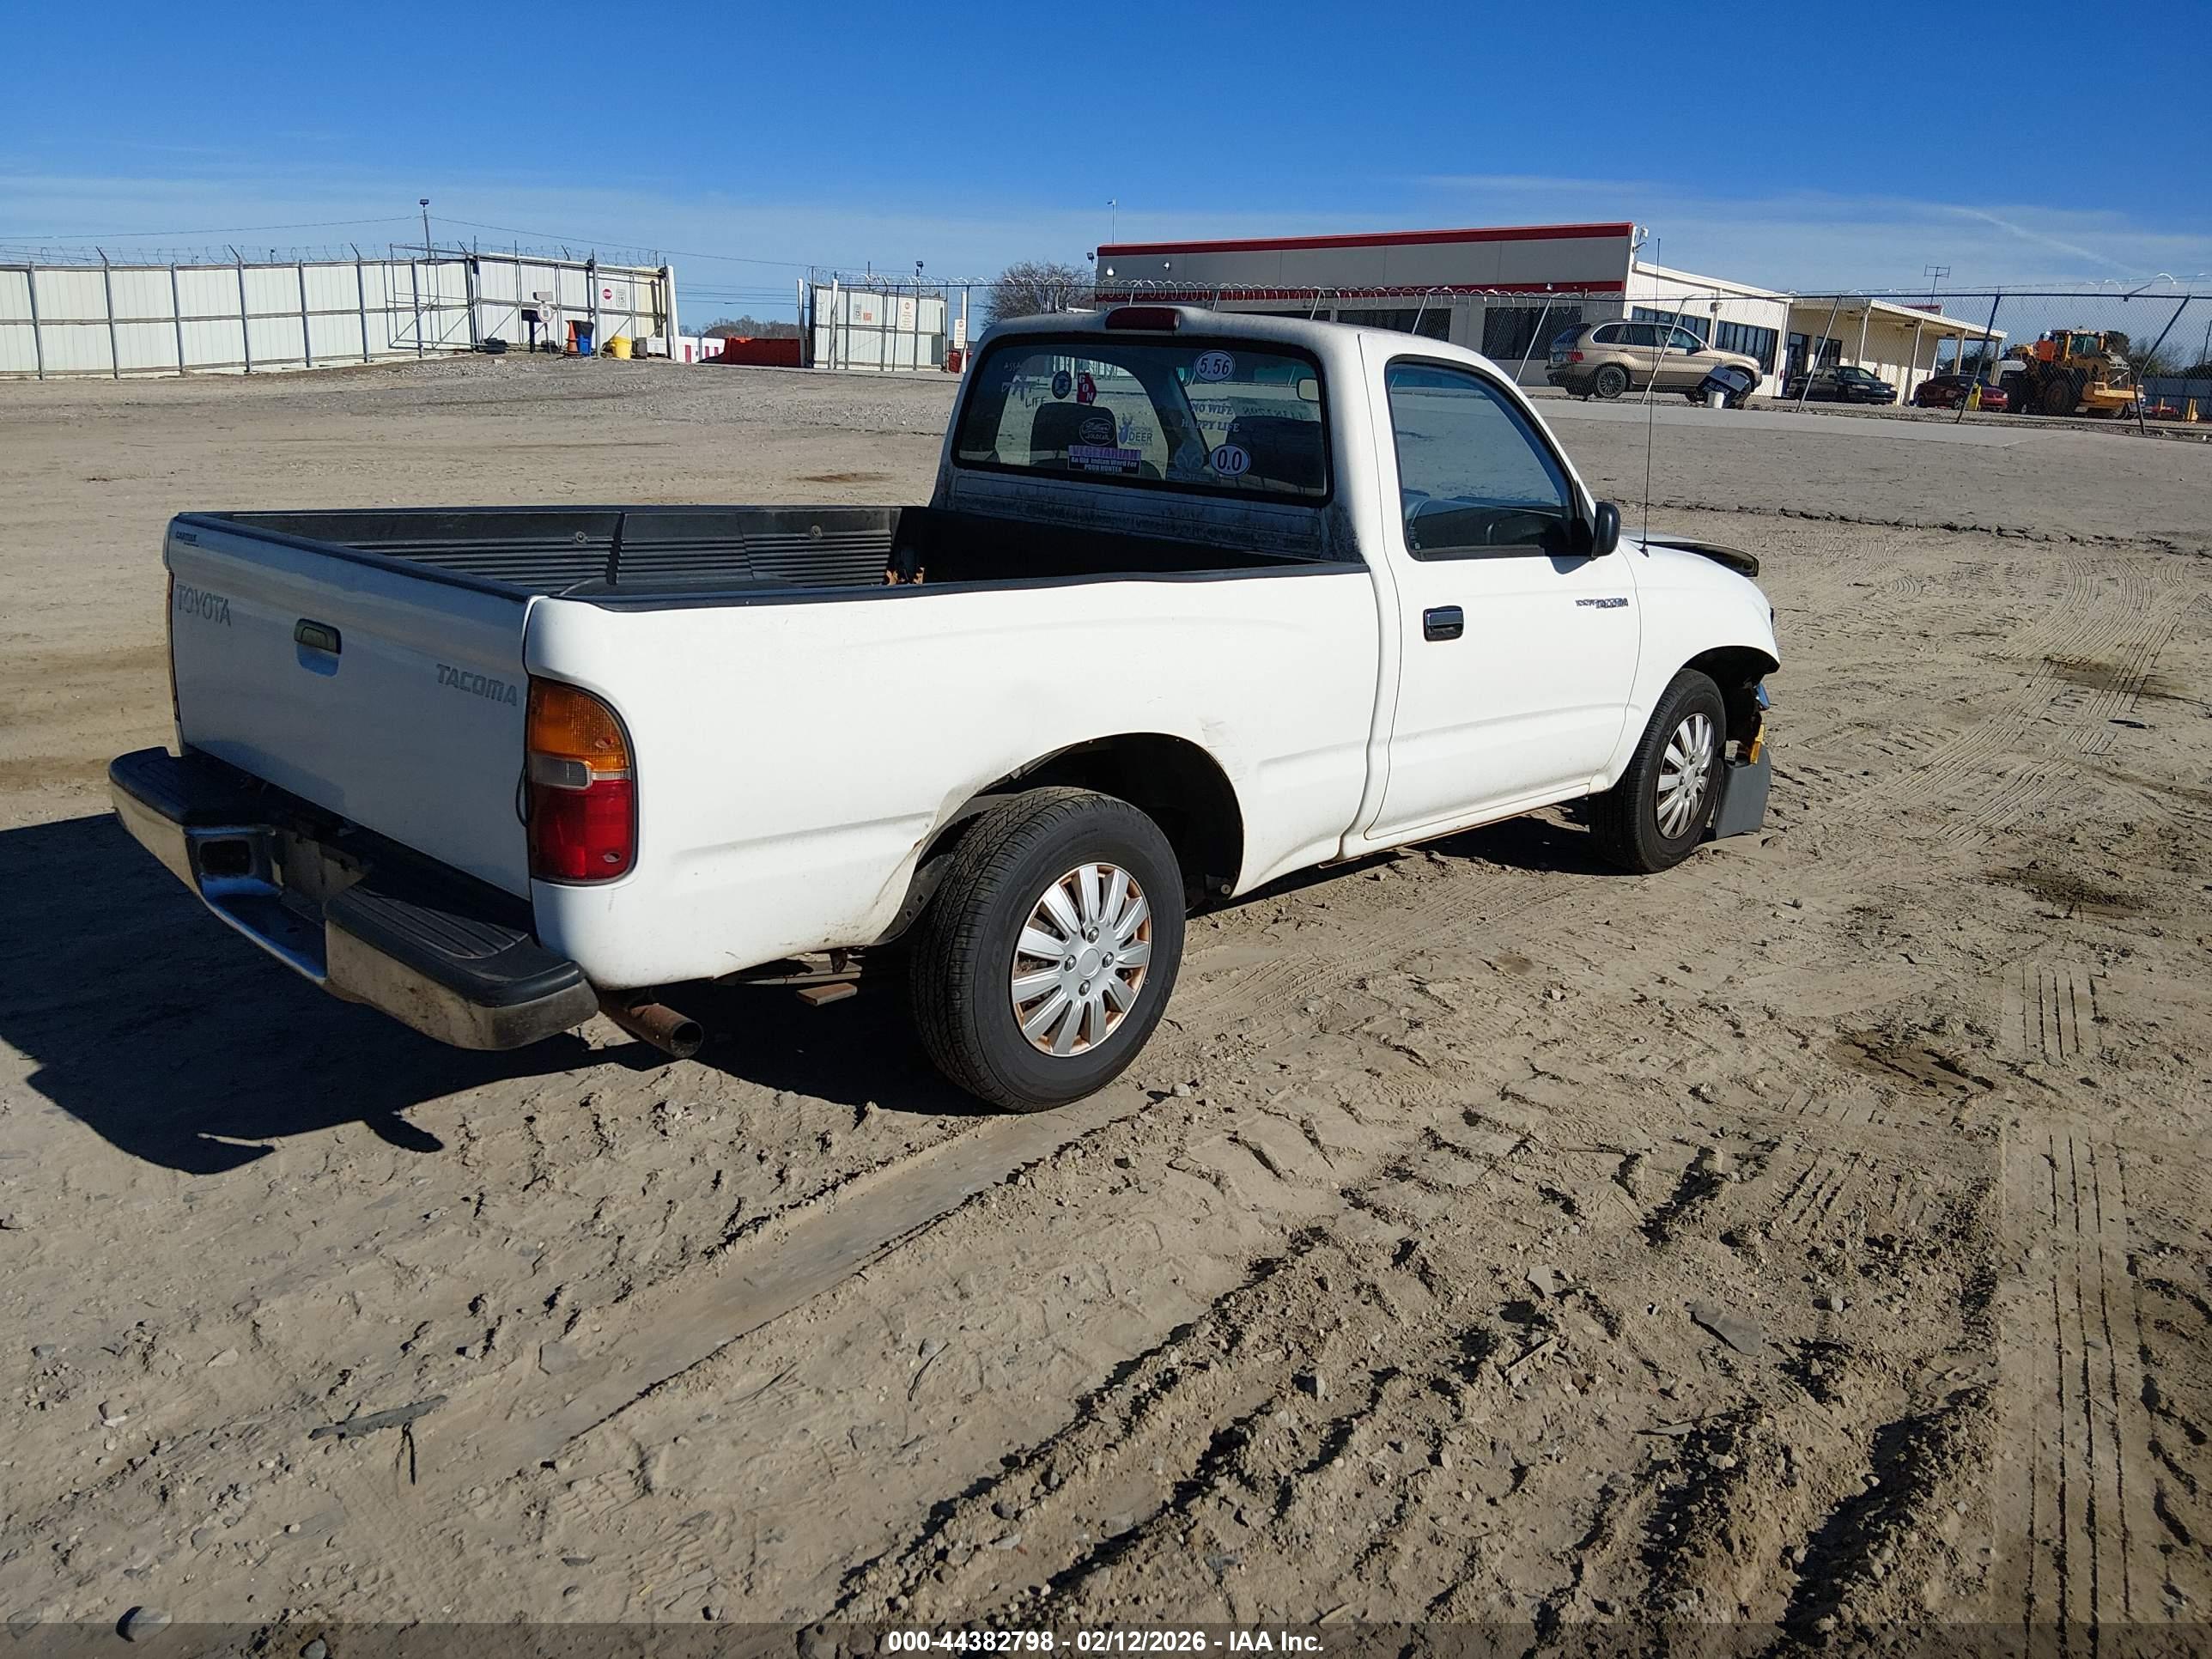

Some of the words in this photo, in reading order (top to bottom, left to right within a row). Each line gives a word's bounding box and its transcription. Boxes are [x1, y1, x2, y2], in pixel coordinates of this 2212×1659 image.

[1199, 357, 1231, 376] 5.56
[1208, 404, 1234, 416] WIFE
[1215, 420, 1241, 433] LIFE
[1128, 432, 1153, 442] DEER
[1217, 449, 1243, 471] 0.0
[176, 584, 231, 629] TOYOTA
[436, 663, 517, 707] TACOMA
